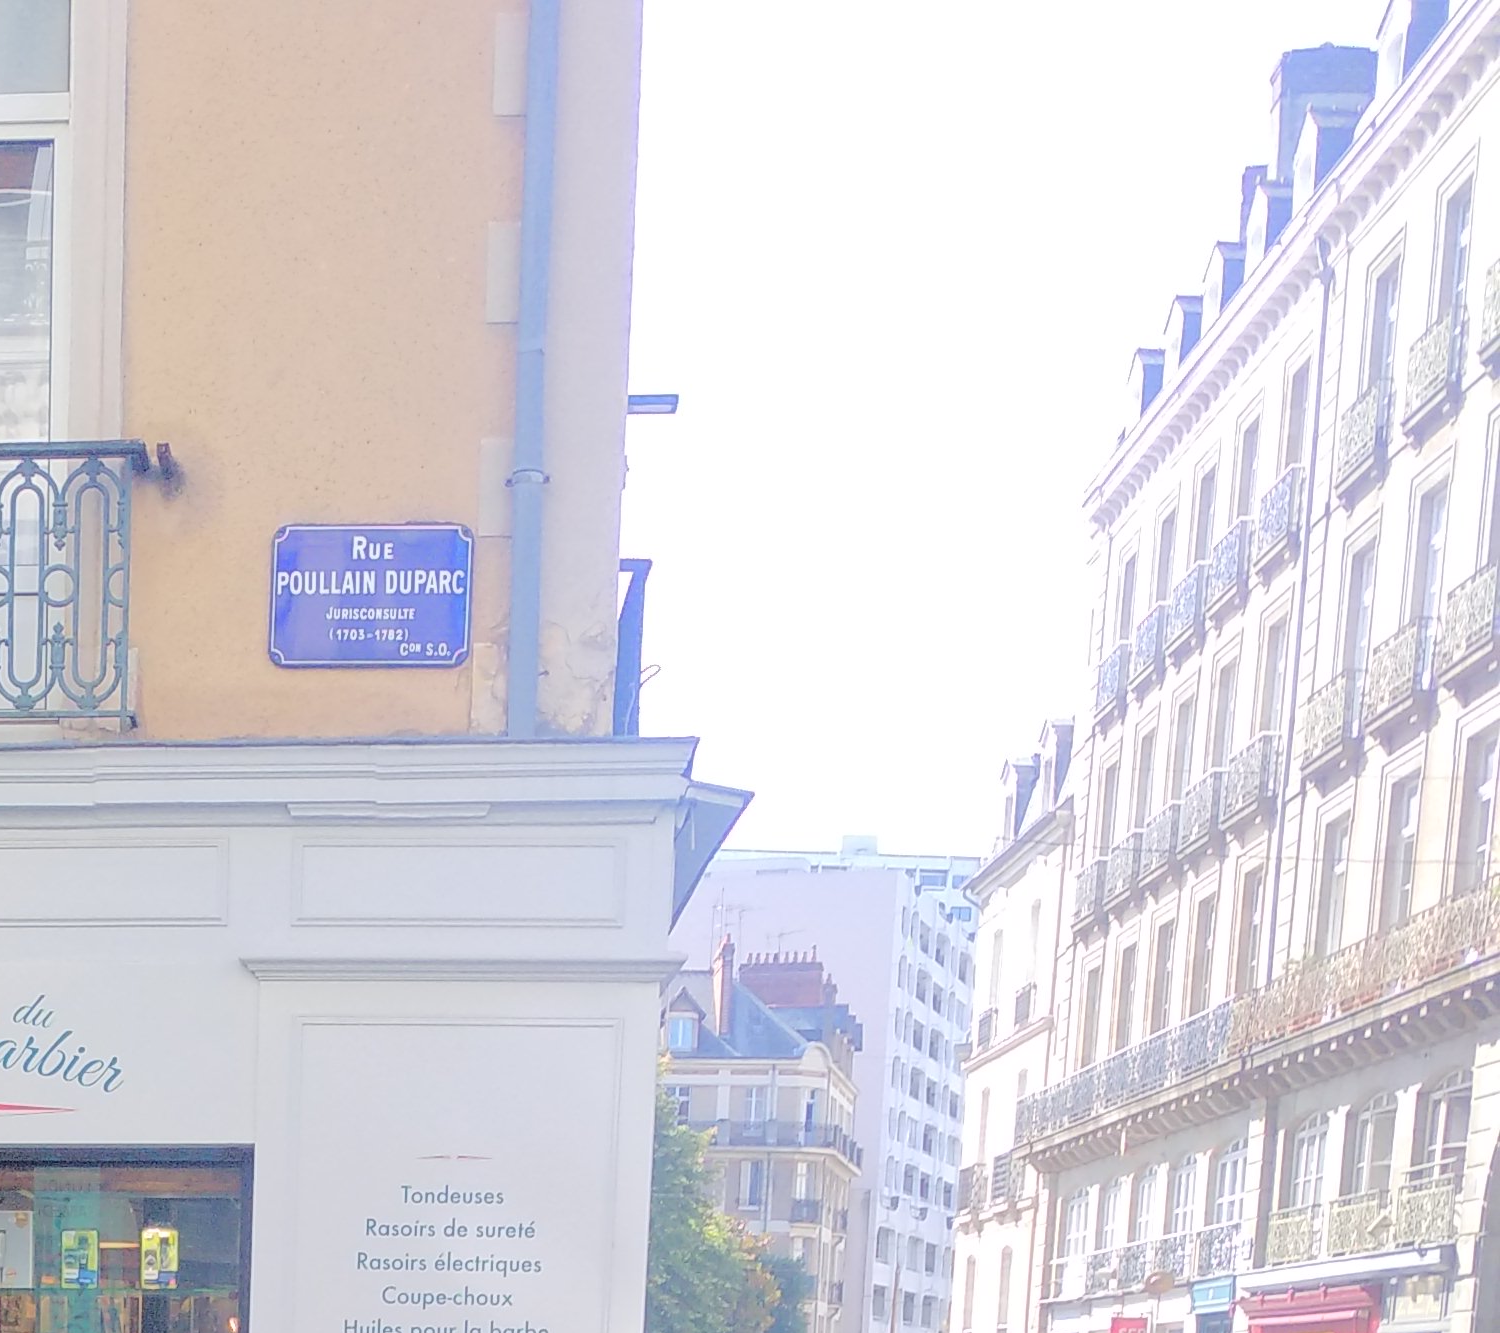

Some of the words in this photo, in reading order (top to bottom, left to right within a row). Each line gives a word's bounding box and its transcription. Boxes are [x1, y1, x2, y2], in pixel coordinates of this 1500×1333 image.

[277, 570, 376, 595] POULLAIN
[385, 570, 465, 594] DUPARC
[326, 606, 415, 620] JURISCONSULTE
[13, 995, 53, 1028] du
[401, 1185, 504, 1205] Tondeuses
[366, 1218, 435, 1237] Rasoirs
[444, 1218, 468, 1238] de
[476, 1221, 535, 1239] sureté
[357, 1252, 427, 1270] Rasoirs
[435, 1252, 542, 1277] électriques
[382, 1286, 513, 1310] Coupe-choux
